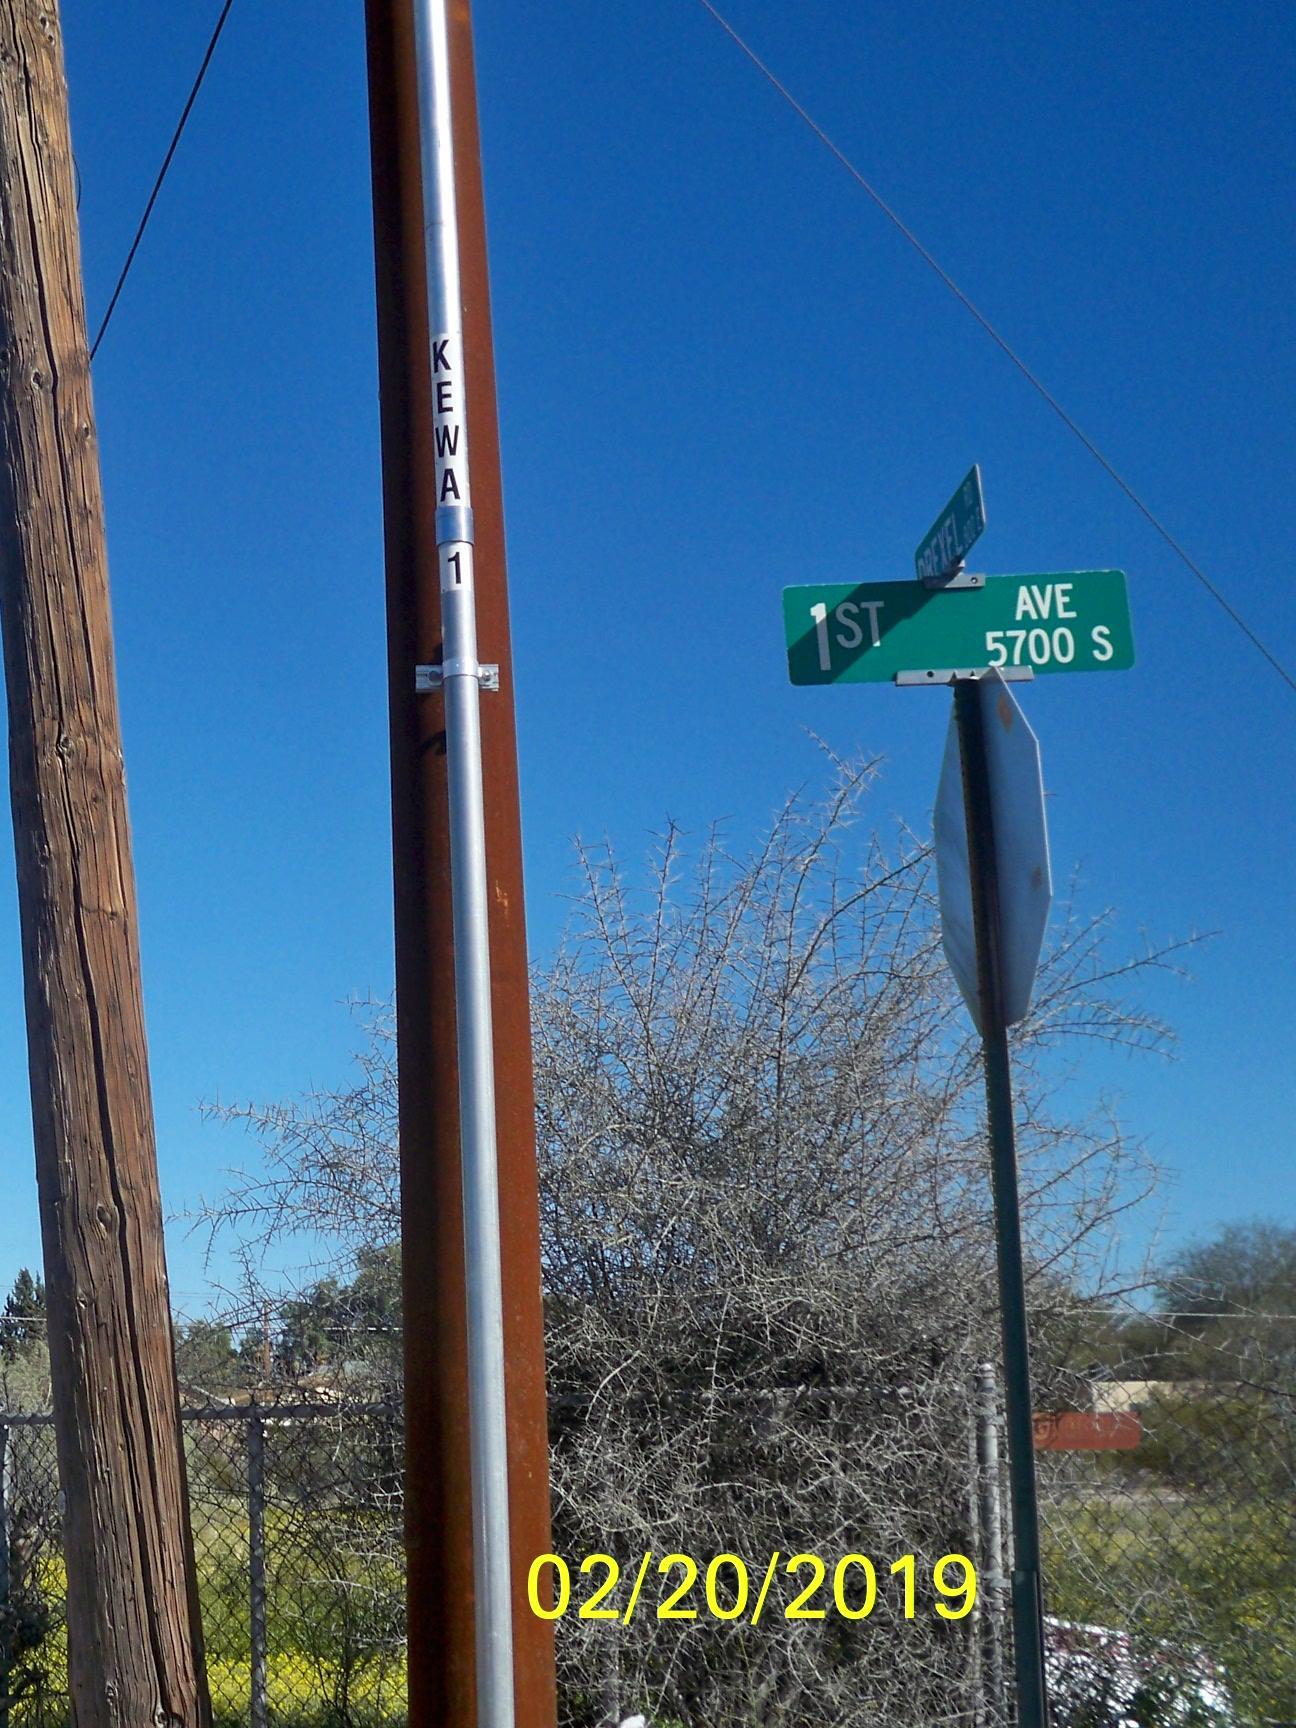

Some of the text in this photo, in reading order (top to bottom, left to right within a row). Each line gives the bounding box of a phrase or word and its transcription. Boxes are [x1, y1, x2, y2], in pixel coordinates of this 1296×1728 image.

[432, 339, 461, 502] KEWA
[447, 551, 462, 584] 1
[809, 583, 1077, 671] 1ST AVE
[985, 625, 1114, 667] 5700 S
